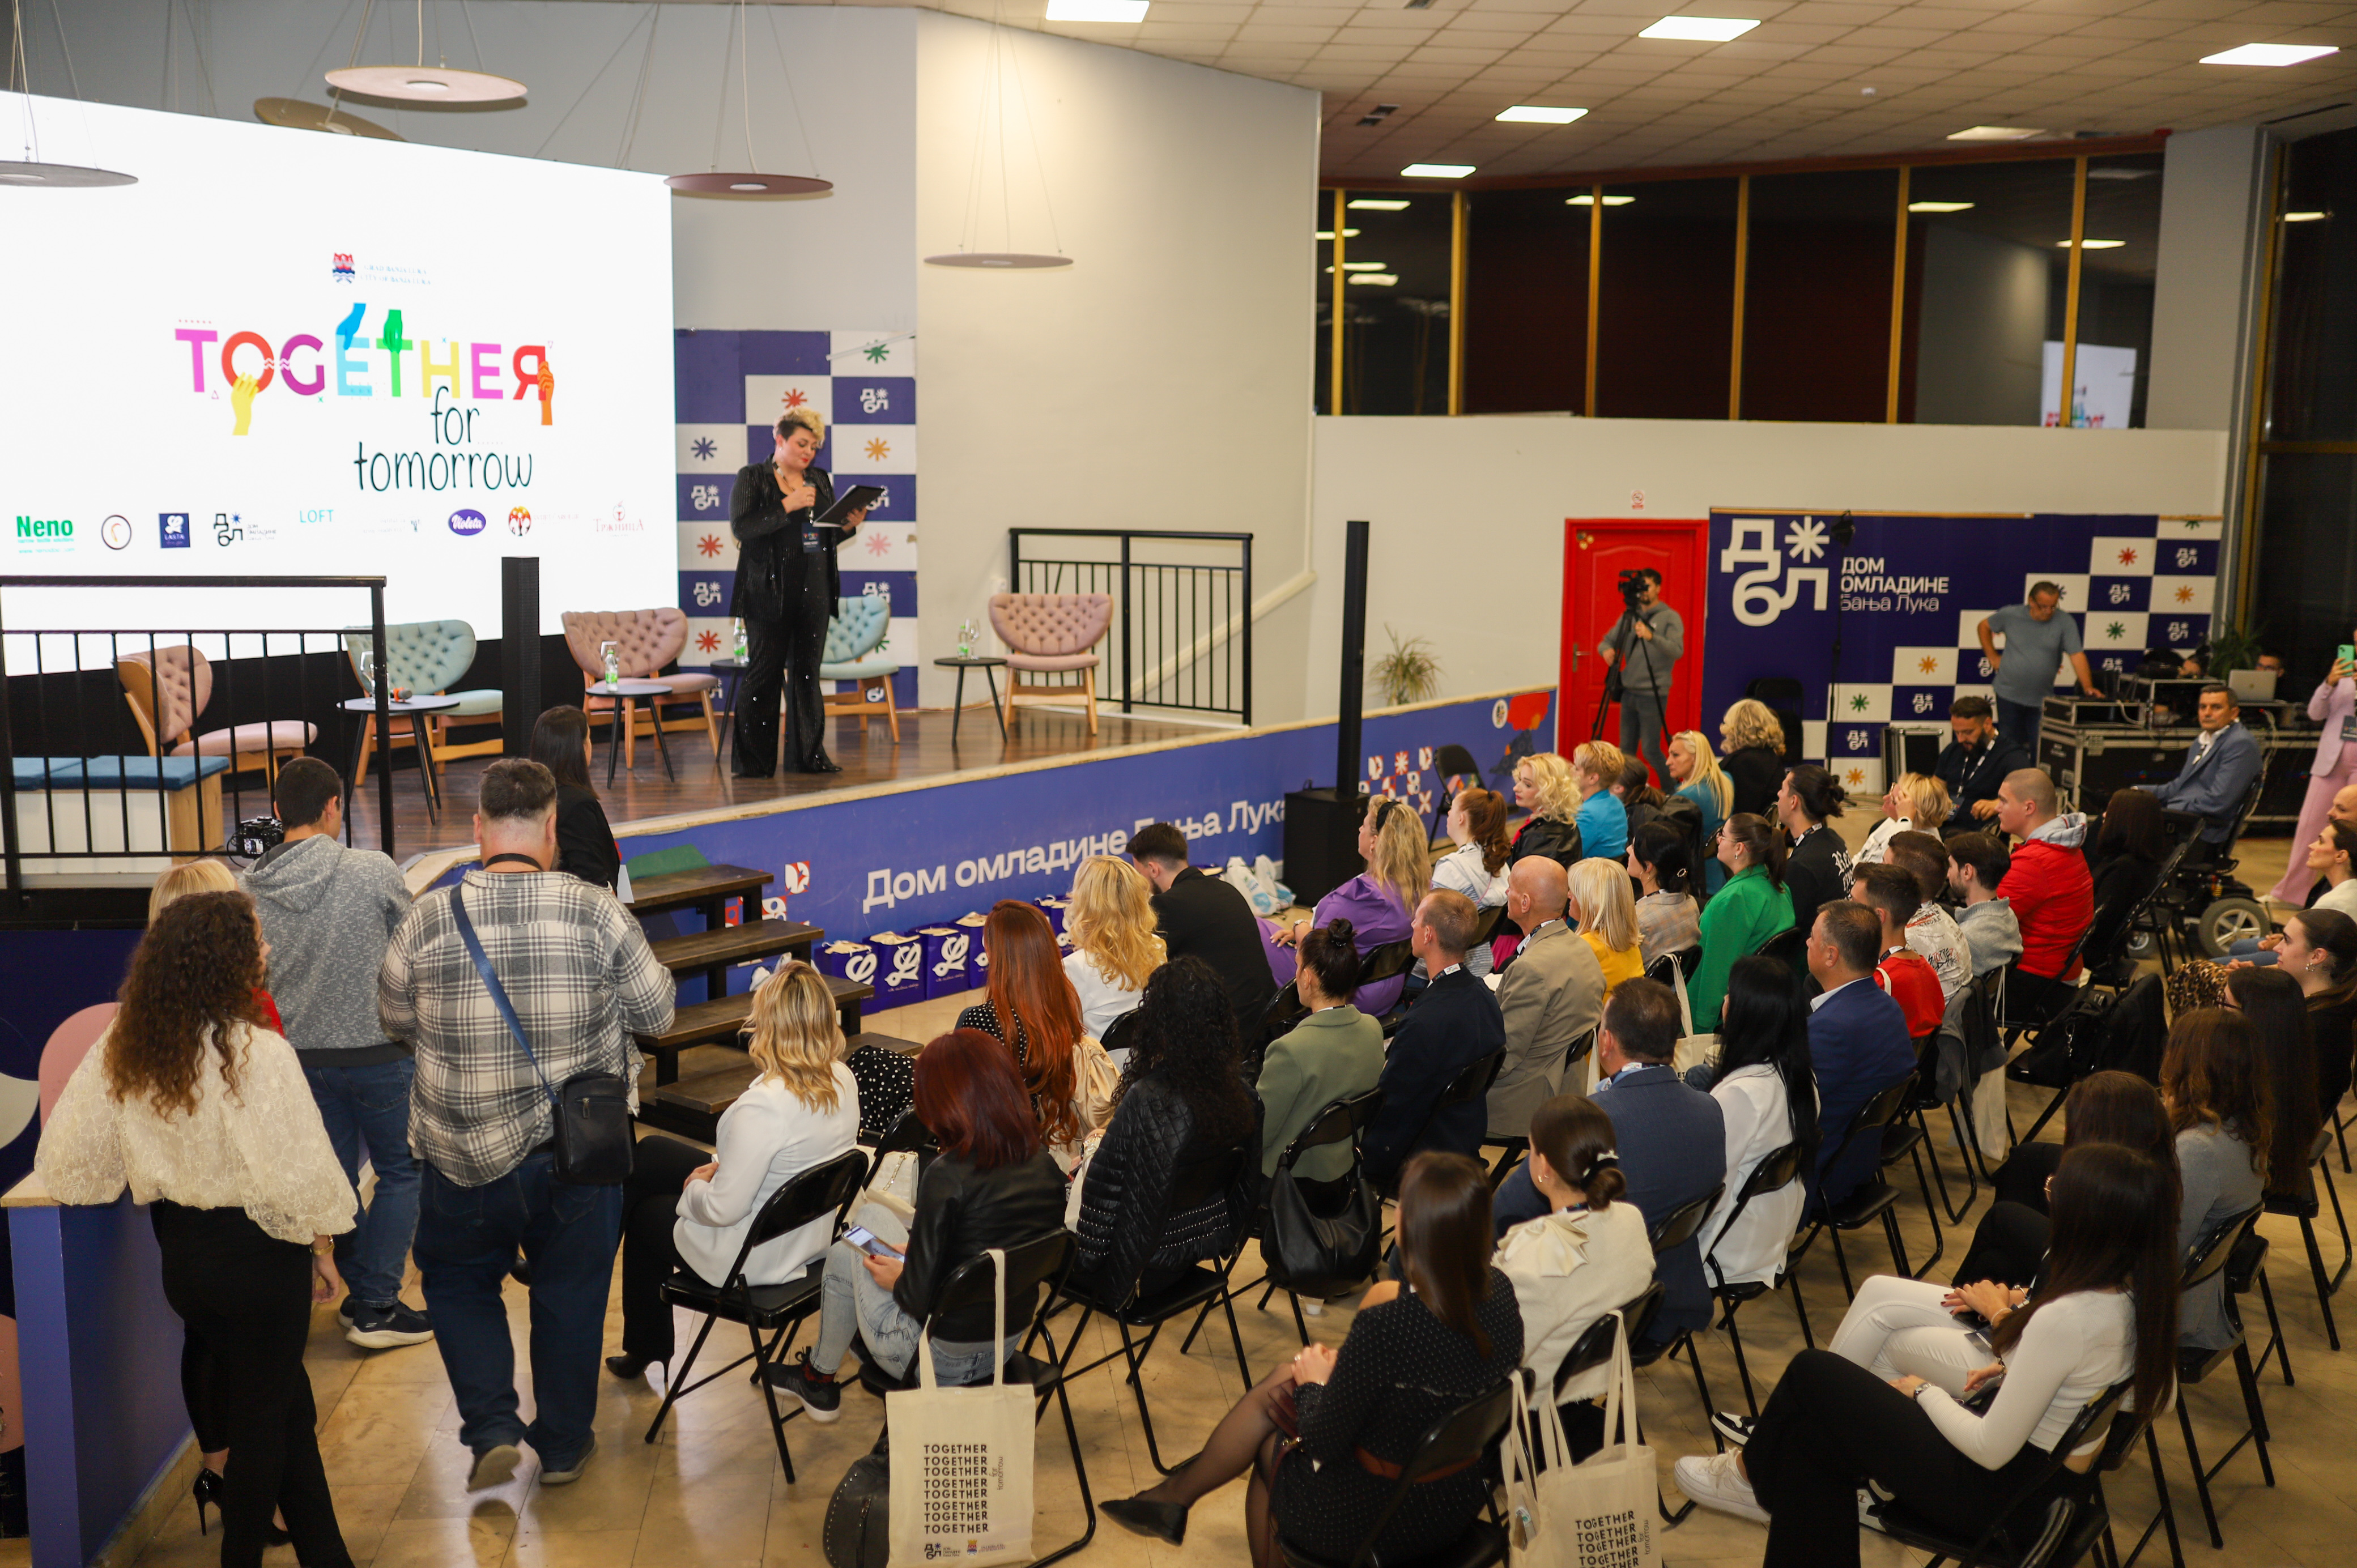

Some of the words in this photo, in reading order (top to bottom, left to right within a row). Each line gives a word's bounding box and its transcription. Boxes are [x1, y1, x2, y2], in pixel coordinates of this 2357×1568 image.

[431, 386, 480, 445] for
[354, 441, 533, 492] tomorrow
[299, 509, 334, 523] LOFT
[450, 514, 483, 530] Violeta
[16, 515, 74, 538] Neno
[1841, 556, 1885, 576] ДОМ
[1840, 576, 1950, 595] ОМЛАДИНЕ
[1840, 594, 1891, 612] Бања
[1895, 594, 1939, 615] Лука
[862, 864, 947, 914] Дом
[954, 829, 1128, 888] омладине
[924, 1444, 988, 1454] TOGETHER
[924, 1456, 988, 1466] TOGETHER
[924, 1467, 988, 1477] TOGETHER
[924, 1478, 988, 1489] TOGETHER
[924, 1489, 988, 1499] TOGETHER
[924, 1501, 988, 1511] TOGETHER
[924, 1511, 988, 1522] TOGETHER
[1575, 1511, 1635, 1529] TOGETHER
[924, 1523, 989, 1534] TOGETHER
[1576, 1523, 1636, 1543] TOGETHER
[1577, 1533, 1637, 1554] TOGETHER
[1579, 1546, 1639, 1566] TOGETHER
